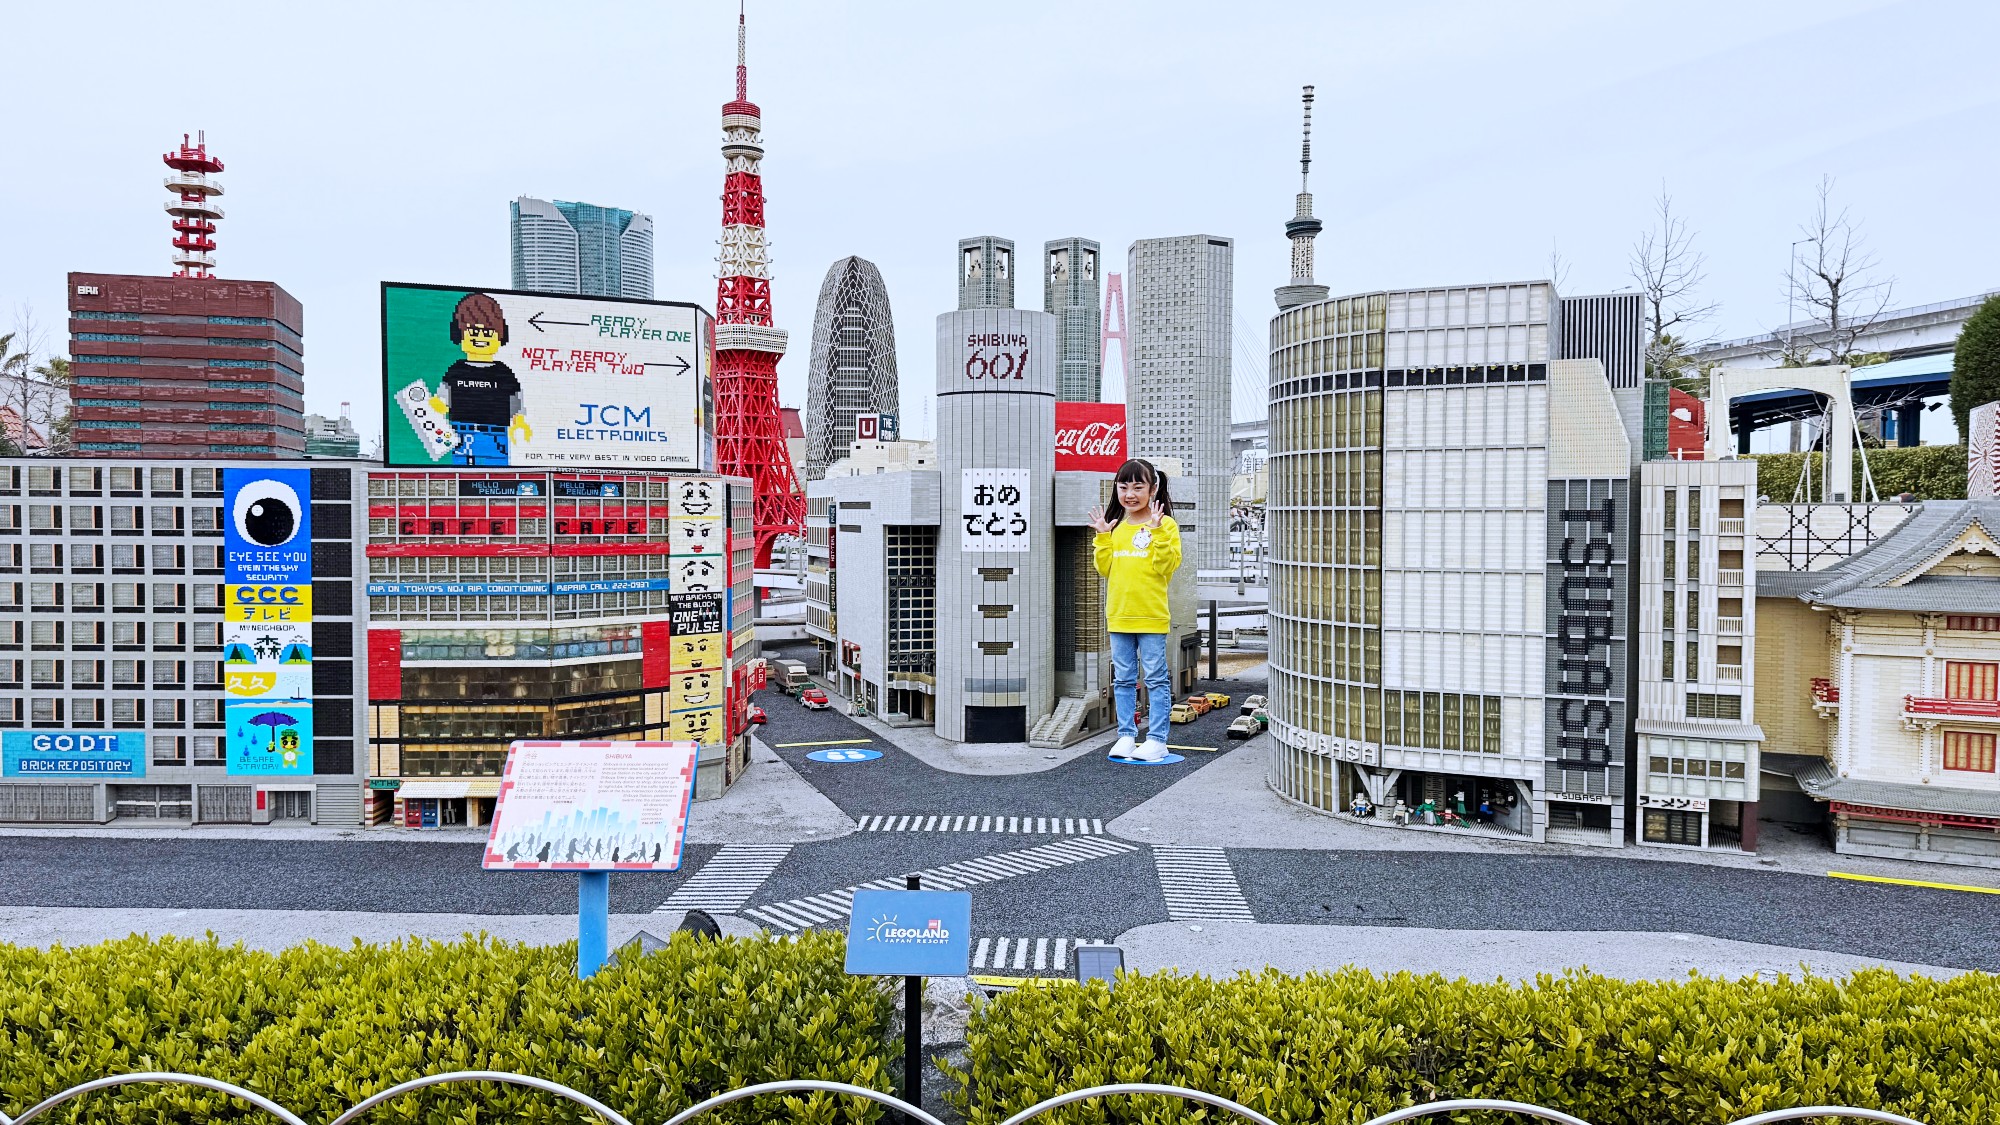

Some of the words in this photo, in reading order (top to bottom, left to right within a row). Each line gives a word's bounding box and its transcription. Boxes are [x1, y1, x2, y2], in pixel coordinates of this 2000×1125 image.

[591, 314, 647, 330] READY
[599, 326, 664, 341] PLAYER
[666, 330, 692, 343] ONE
[967, 333, 1028, 348] SHIBUYA
[521, 347, 559, 360] NOT
[570, 350, 628, 364] READY
[530, 359, 596, 373] PLAYER
[607, 362, 645, 375] TWO
[966, 348, 1029, 380] 601
[457, 380, 492, 388] PLAYER
[574, 403, 651, 428] JCM
[557, 428, 668, 442] ELECTRONICS
[861, 420, 874, 436] U
[1055, 422, 1126, 456] ca-Cola
[471, 481, 499, 489] HELLO
[559, 481, 585, 489] HELLO
[566, 488, 599, 496] PENGUIN
[973, 484, 1021, 506] おめ
[401, 520, 504, 535] CAFE
[555, 521, 640, 535] CAFE
[962, 512, 1027, 536] でとう
[229, 551, 252, 562] EYE
[256, 551, 280, 562] SEE
[283, 552, 307, 562] YOU
[237, 564, 252, 572] EYE
[252, 564, 261, 572] IN
[262, 564, 280, 572] THE
[280, 564, 299, 572] SKY
[369, 585, 385, 593] AIR
[388, 585, 400, 593] ON
[404, 585, 444, 593] TOKYO'S
[467, 585, 483, 593] AIR
[487, 585, 548, 593] CONDITIONING
[556, 583, 587, 592] REPAIR
[590, 583, 609, 591] CALL
[612, 581, 650, 590] 222-0937
[236, 586, 299, 603] CCC
[685, 593, 712, 601] BRICKS
[243, 607, 291, 620] テレビ
[672, 610, 699, 623] ONE
[677, 620, 720, 635] PULSE
[1556, 498, 1614, 771] TSUBASA
[227, 675, 269, 690] 久久
[33, 734, 117, 752] GODT
[1289, 727, 1377, 766] TSUBASA
[21, 760, 55, 771] BRICK
[58, 760, 131, 771] REPOSITORY
[1553, 792, 1603, 802] TSUBASA
[1639, 795, 1691, 809] ラーメン
[1692, 800, 1706, 810] 24
[885, 925, 950, 939] LEGOLAND
